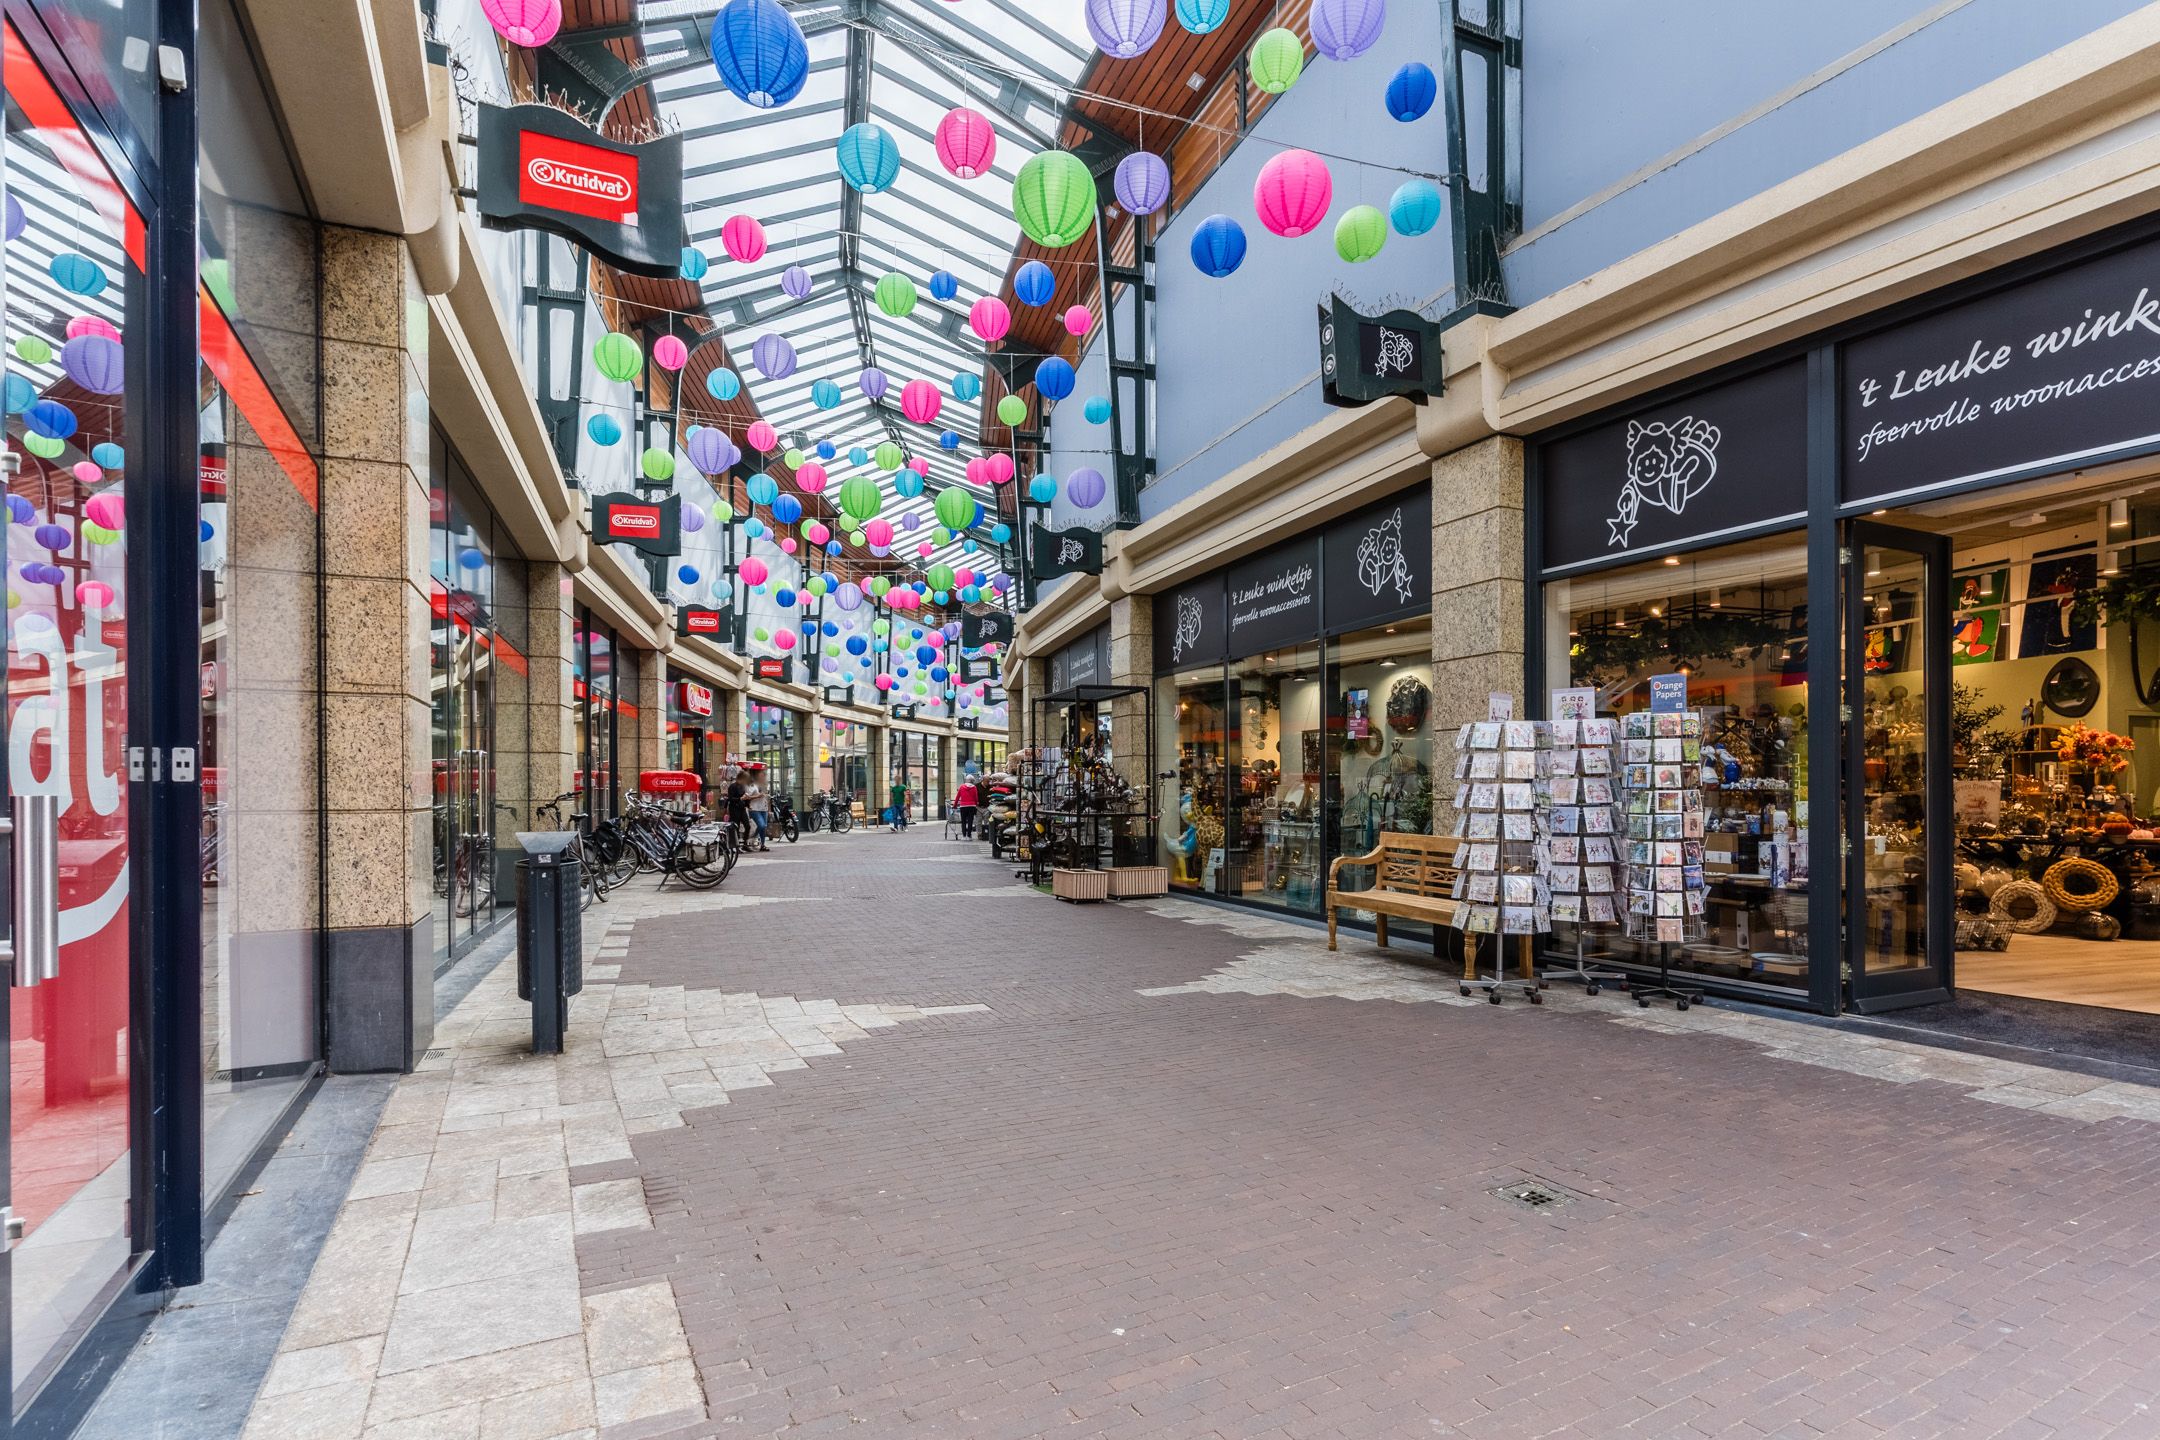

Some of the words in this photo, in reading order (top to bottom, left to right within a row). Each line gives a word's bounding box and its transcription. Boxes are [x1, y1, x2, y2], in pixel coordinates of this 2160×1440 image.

[555, 167, 624, 196] Kruidvat
[1889, 339, 2012, 401] Leuke
[2025, 287, 2160, 359] wink
[1858, 397, 1981, 463] sfeervolle
[623, 517, 653, 526] Kruidvat
[1239, 581, 1265, 604] Leuke
[1266, 564, 1312, 594] winkeltje
[1232, 607, 1259, 632] sfeervolle
[1260, 594, 1311, 617] woonaccessoires
[1653, 681, 1683, 691] Orange
[1656, 691, 1682, 700] Papers
